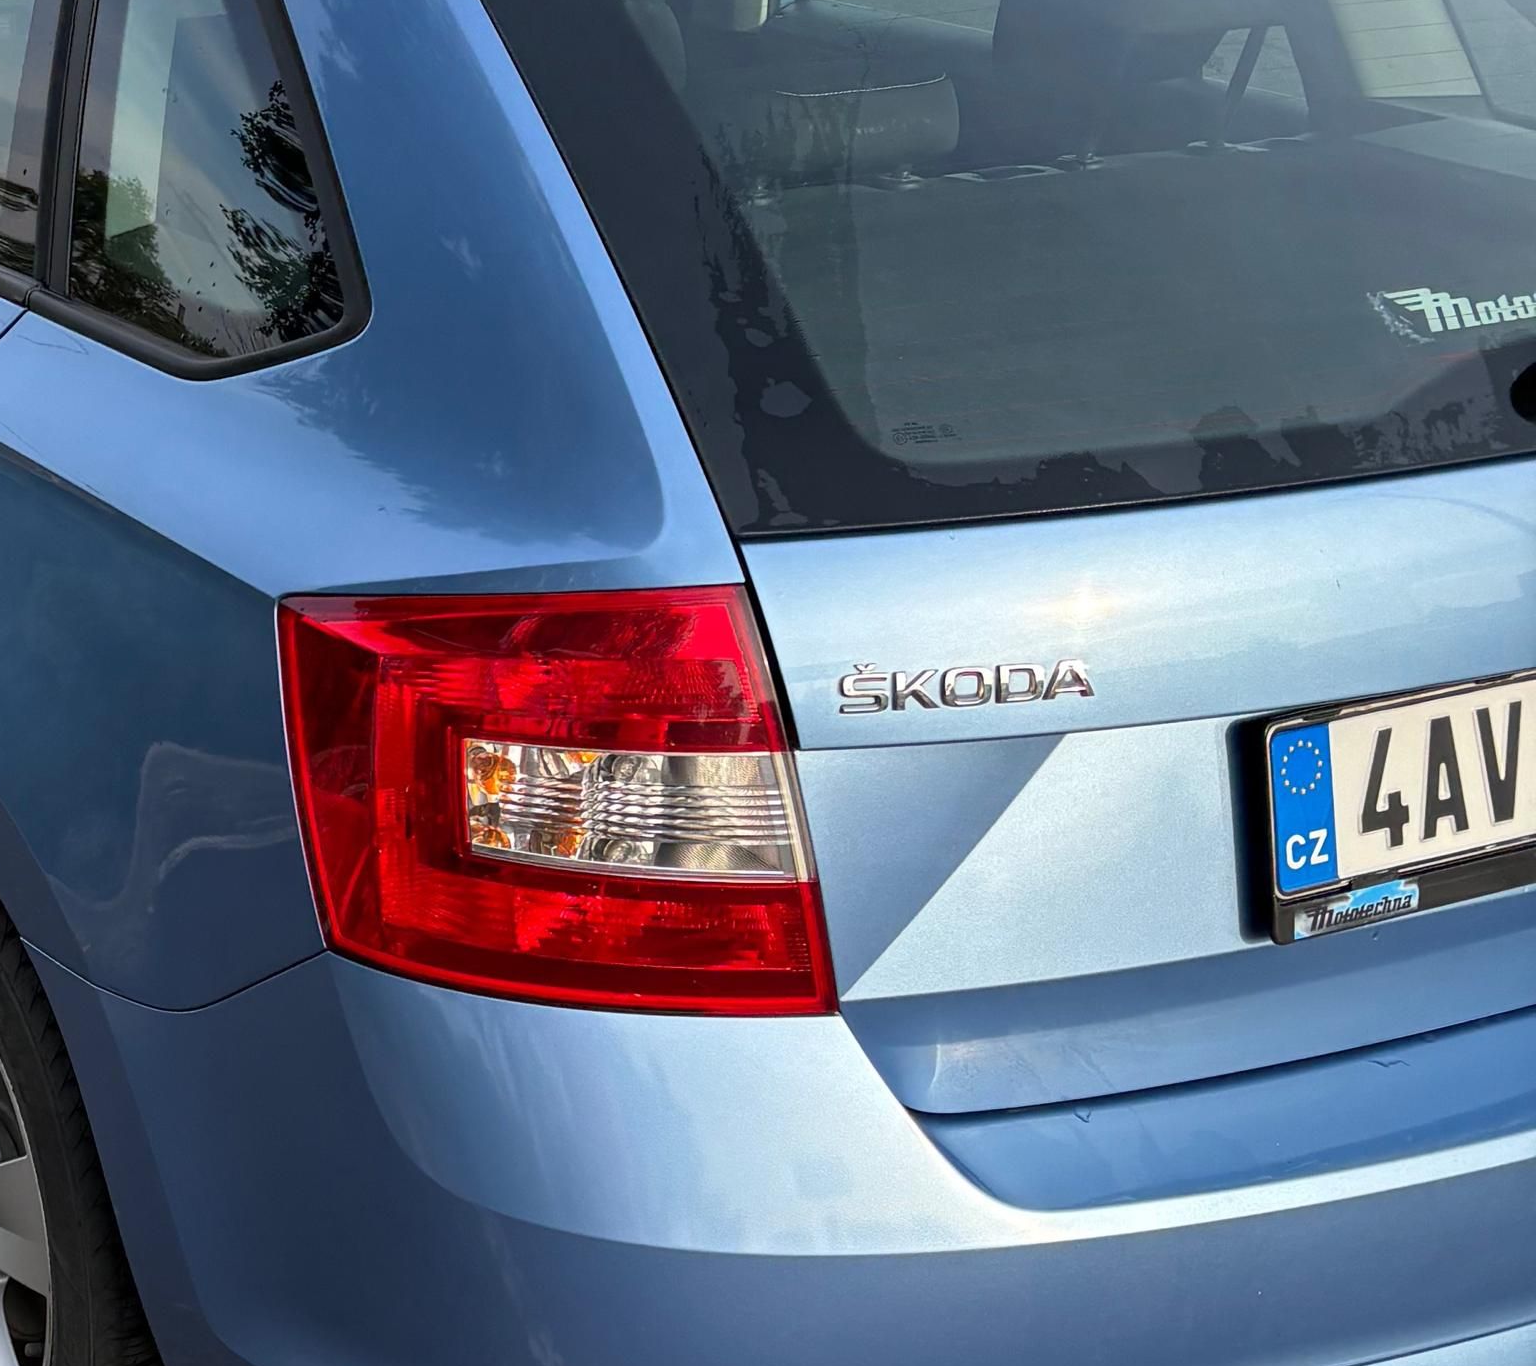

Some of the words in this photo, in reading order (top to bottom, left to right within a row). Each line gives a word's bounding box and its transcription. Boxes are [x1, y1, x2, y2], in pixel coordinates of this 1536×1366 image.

[1383, 287, 1536, 333] Moto
[838, 659, 1095, 715] ŠKODA
[1358, 700, 1522, 850] 4AV
[1285, 828, 1329, 870] CZ
[1305, 893, 1413, 932] Mototechna
